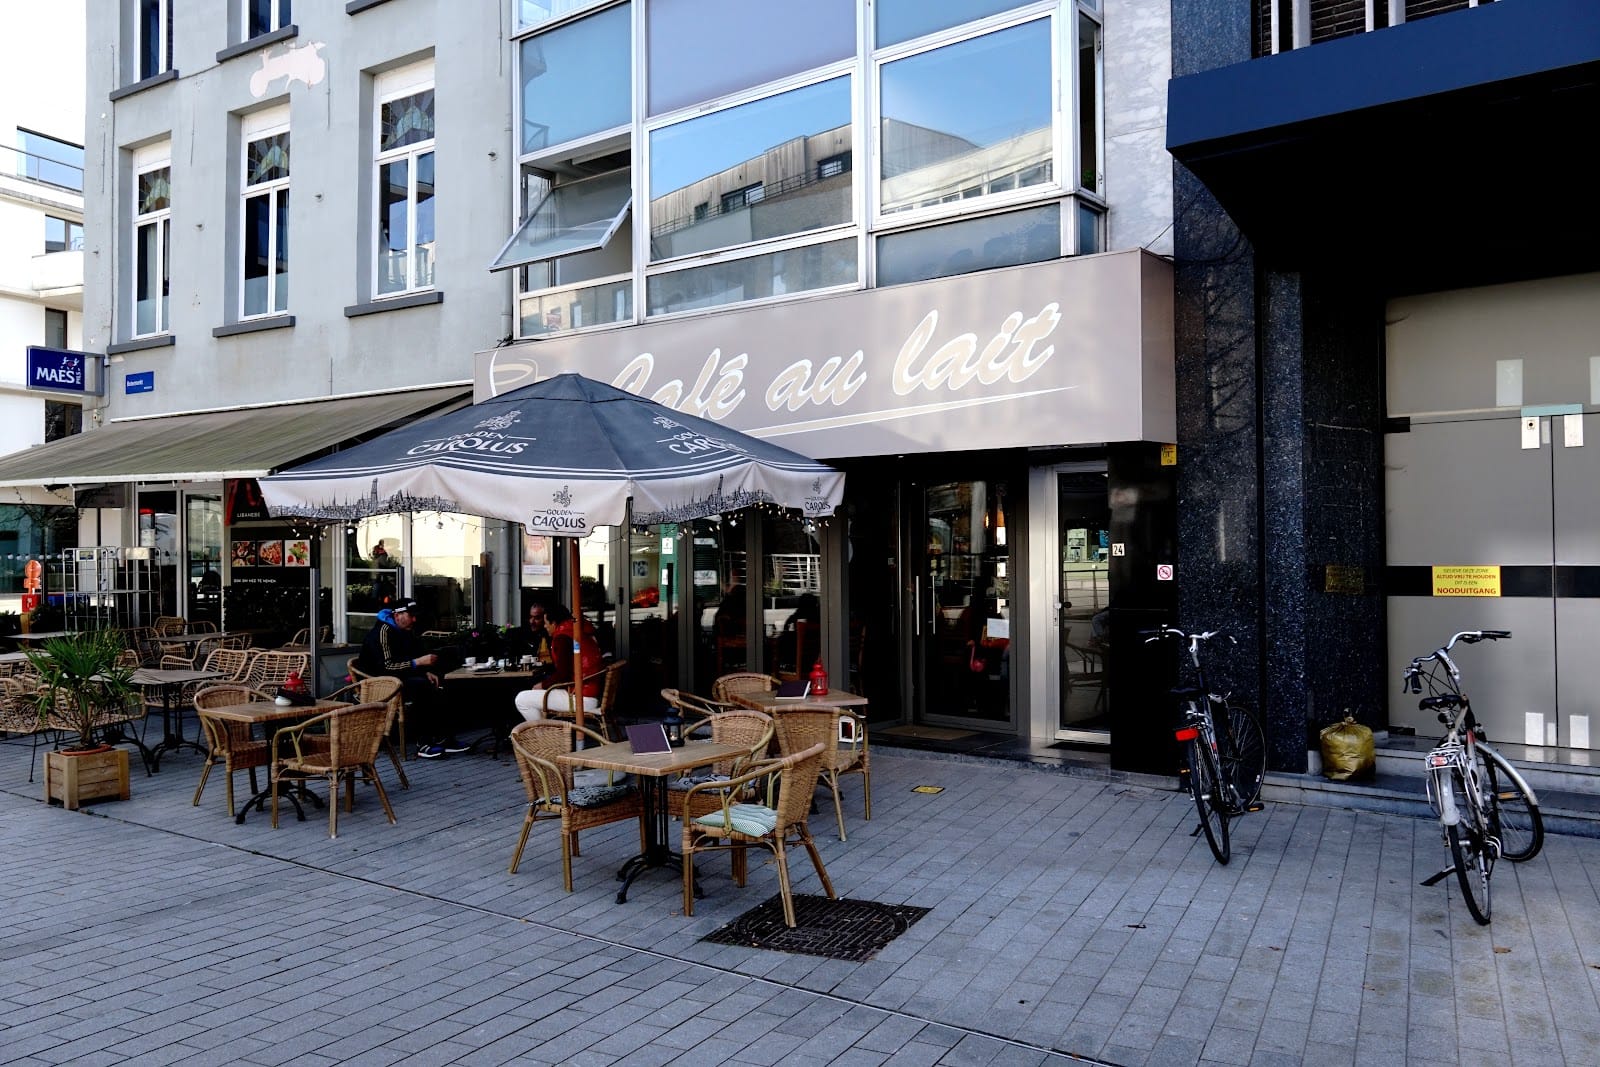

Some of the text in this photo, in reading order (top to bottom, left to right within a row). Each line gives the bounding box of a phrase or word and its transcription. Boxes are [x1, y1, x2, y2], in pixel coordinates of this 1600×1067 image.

[766, 350, 867, 411] au
[893, 302, 1062, 396] lait
[36, 366, 76, 383] MAES
[407, 437, 529, 455] CAROLUS
[532, 515, 586, 530] CAROLUS
[1113, 545, 1123, 555] 24
